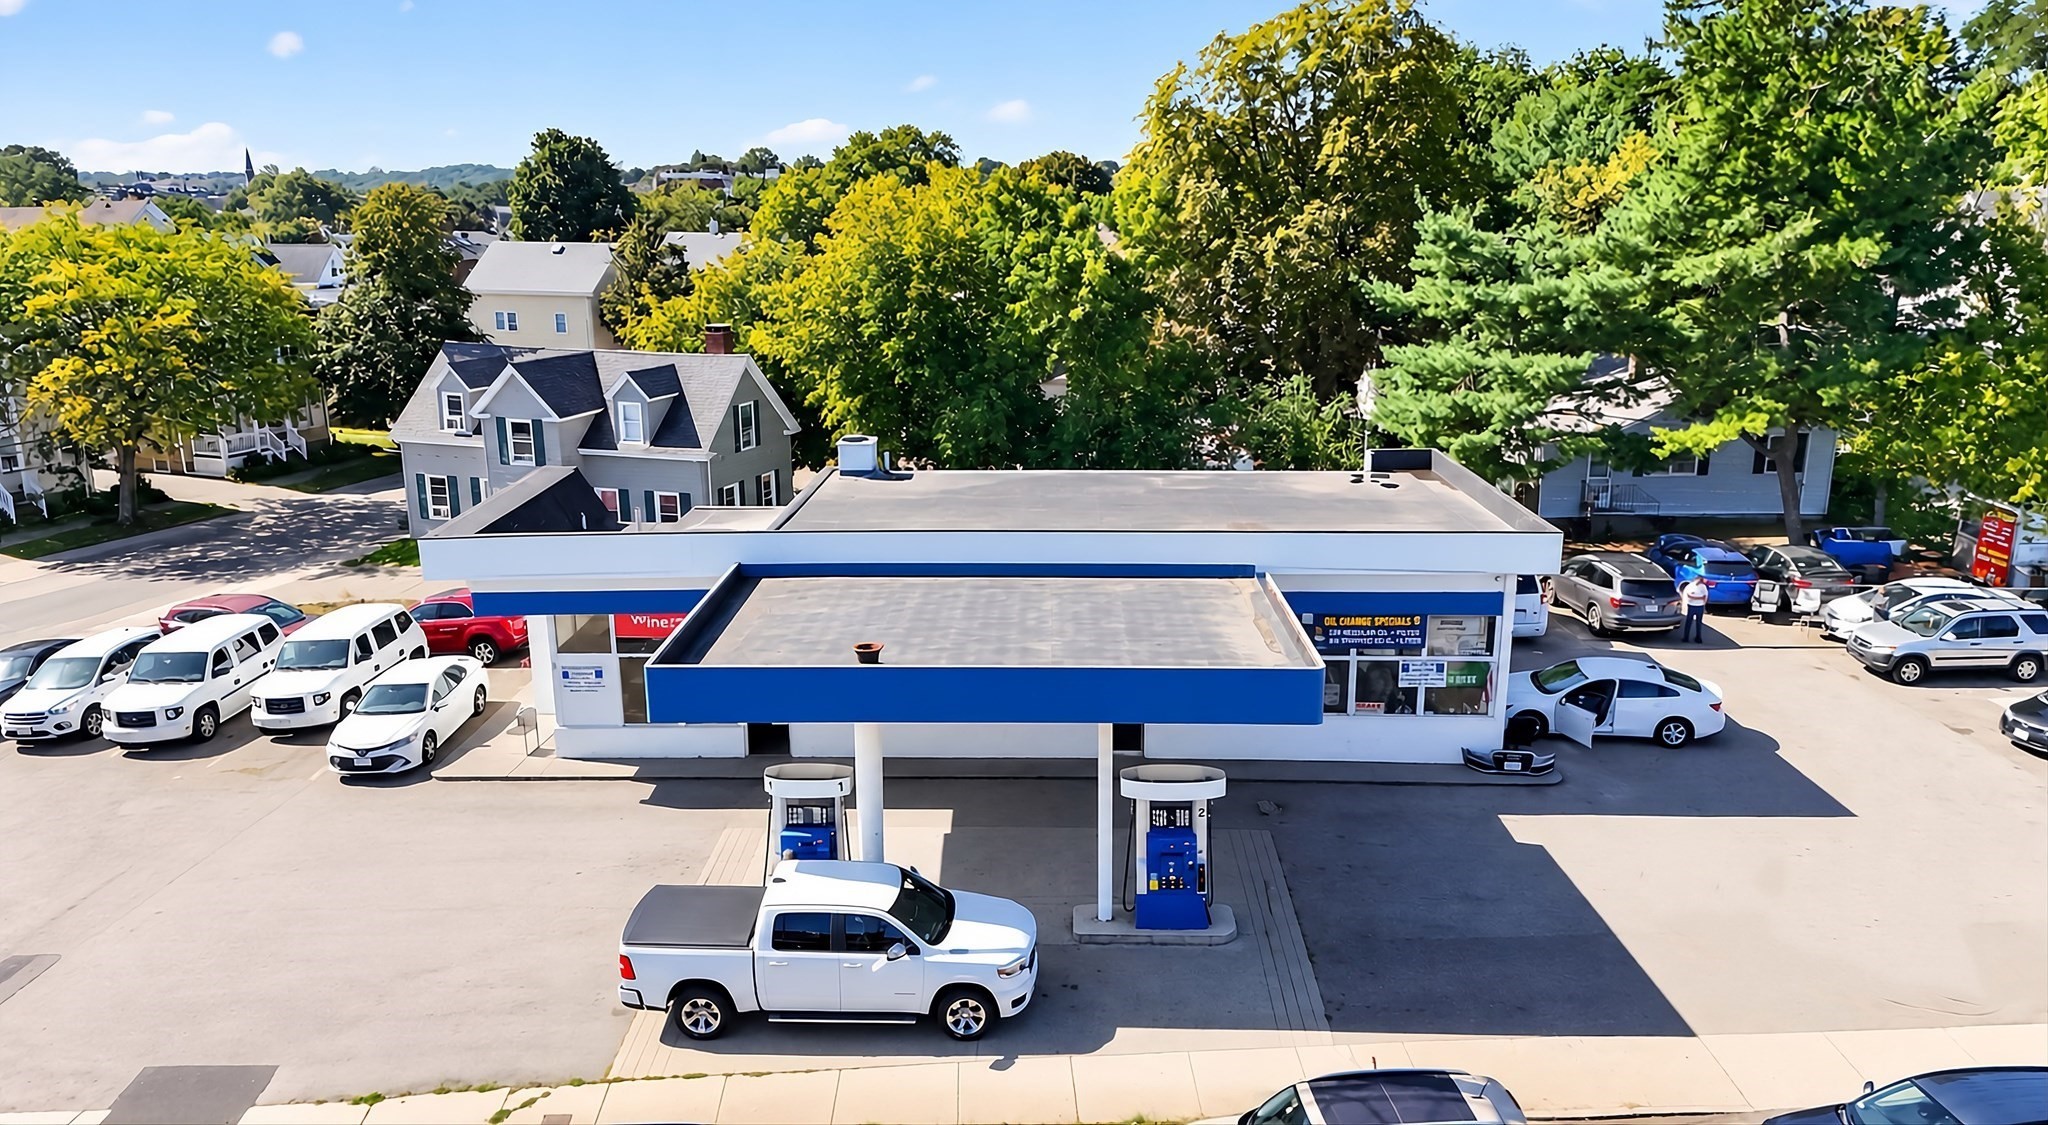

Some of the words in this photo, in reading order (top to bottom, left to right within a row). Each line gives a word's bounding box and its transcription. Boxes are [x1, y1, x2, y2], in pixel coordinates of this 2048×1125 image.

[1324, 616, 1337, 626] OIL
[1339, 616, 1372, 626] CHANGE
[1374, 616, 1411, 626] SPECIALS
[838, 781, 844, 792] 1
[1198, 807, 1206, 817] 2
